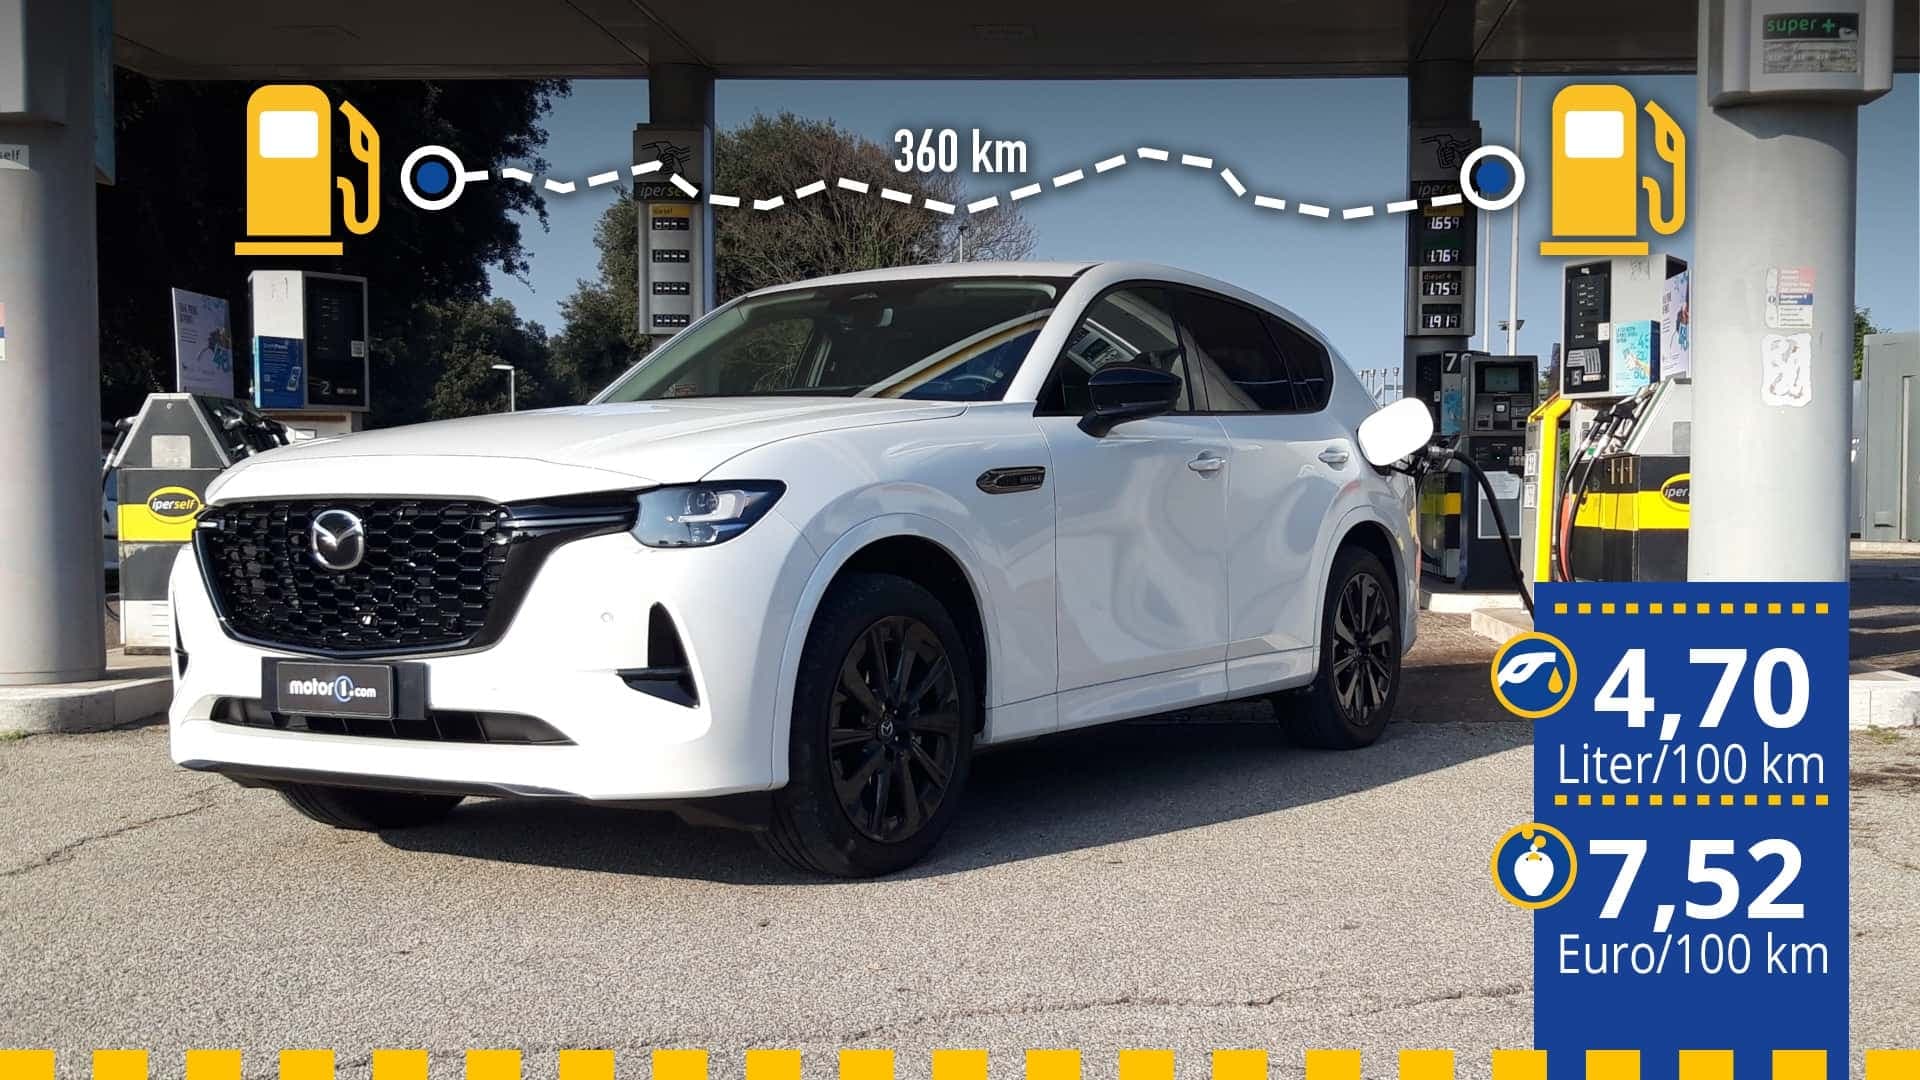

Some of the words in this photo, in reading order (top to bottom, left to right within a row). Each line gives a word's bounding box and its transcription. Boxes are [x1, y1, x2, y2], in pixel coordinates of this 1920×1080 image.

[1767, 17, 1817, 36] super
[1444, 353, 1458, 372] 7
[1664, 485, 1690, 499] iper
[151, 498, 196, 511] iperself
[289, 675, 376, 701] motor1.com
